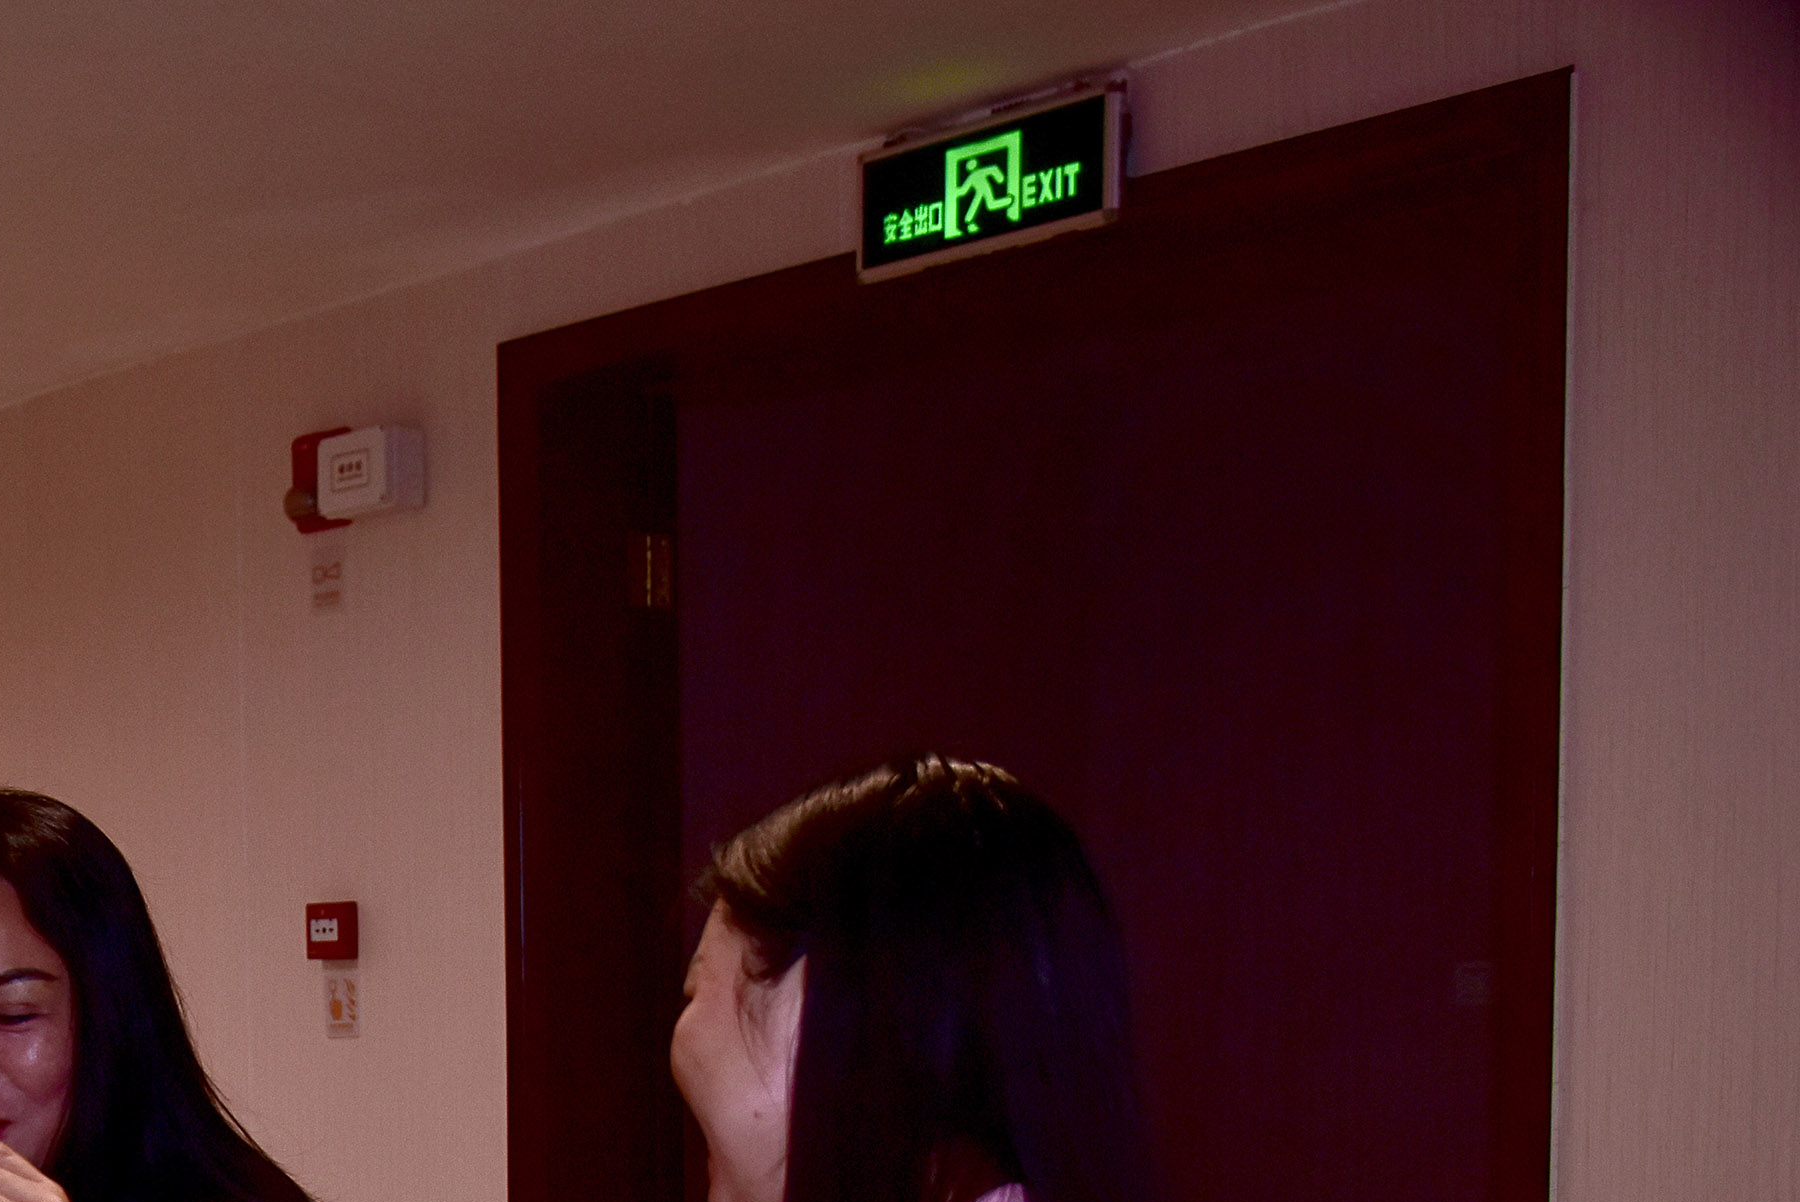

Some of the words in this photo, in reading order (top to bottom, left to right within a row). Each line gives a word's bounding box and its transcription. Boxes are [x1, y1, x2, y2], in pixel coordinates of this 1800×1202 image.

[1022, 161, 1081, 209] EXIT
[883, 200, 944, 245] 安全出口
